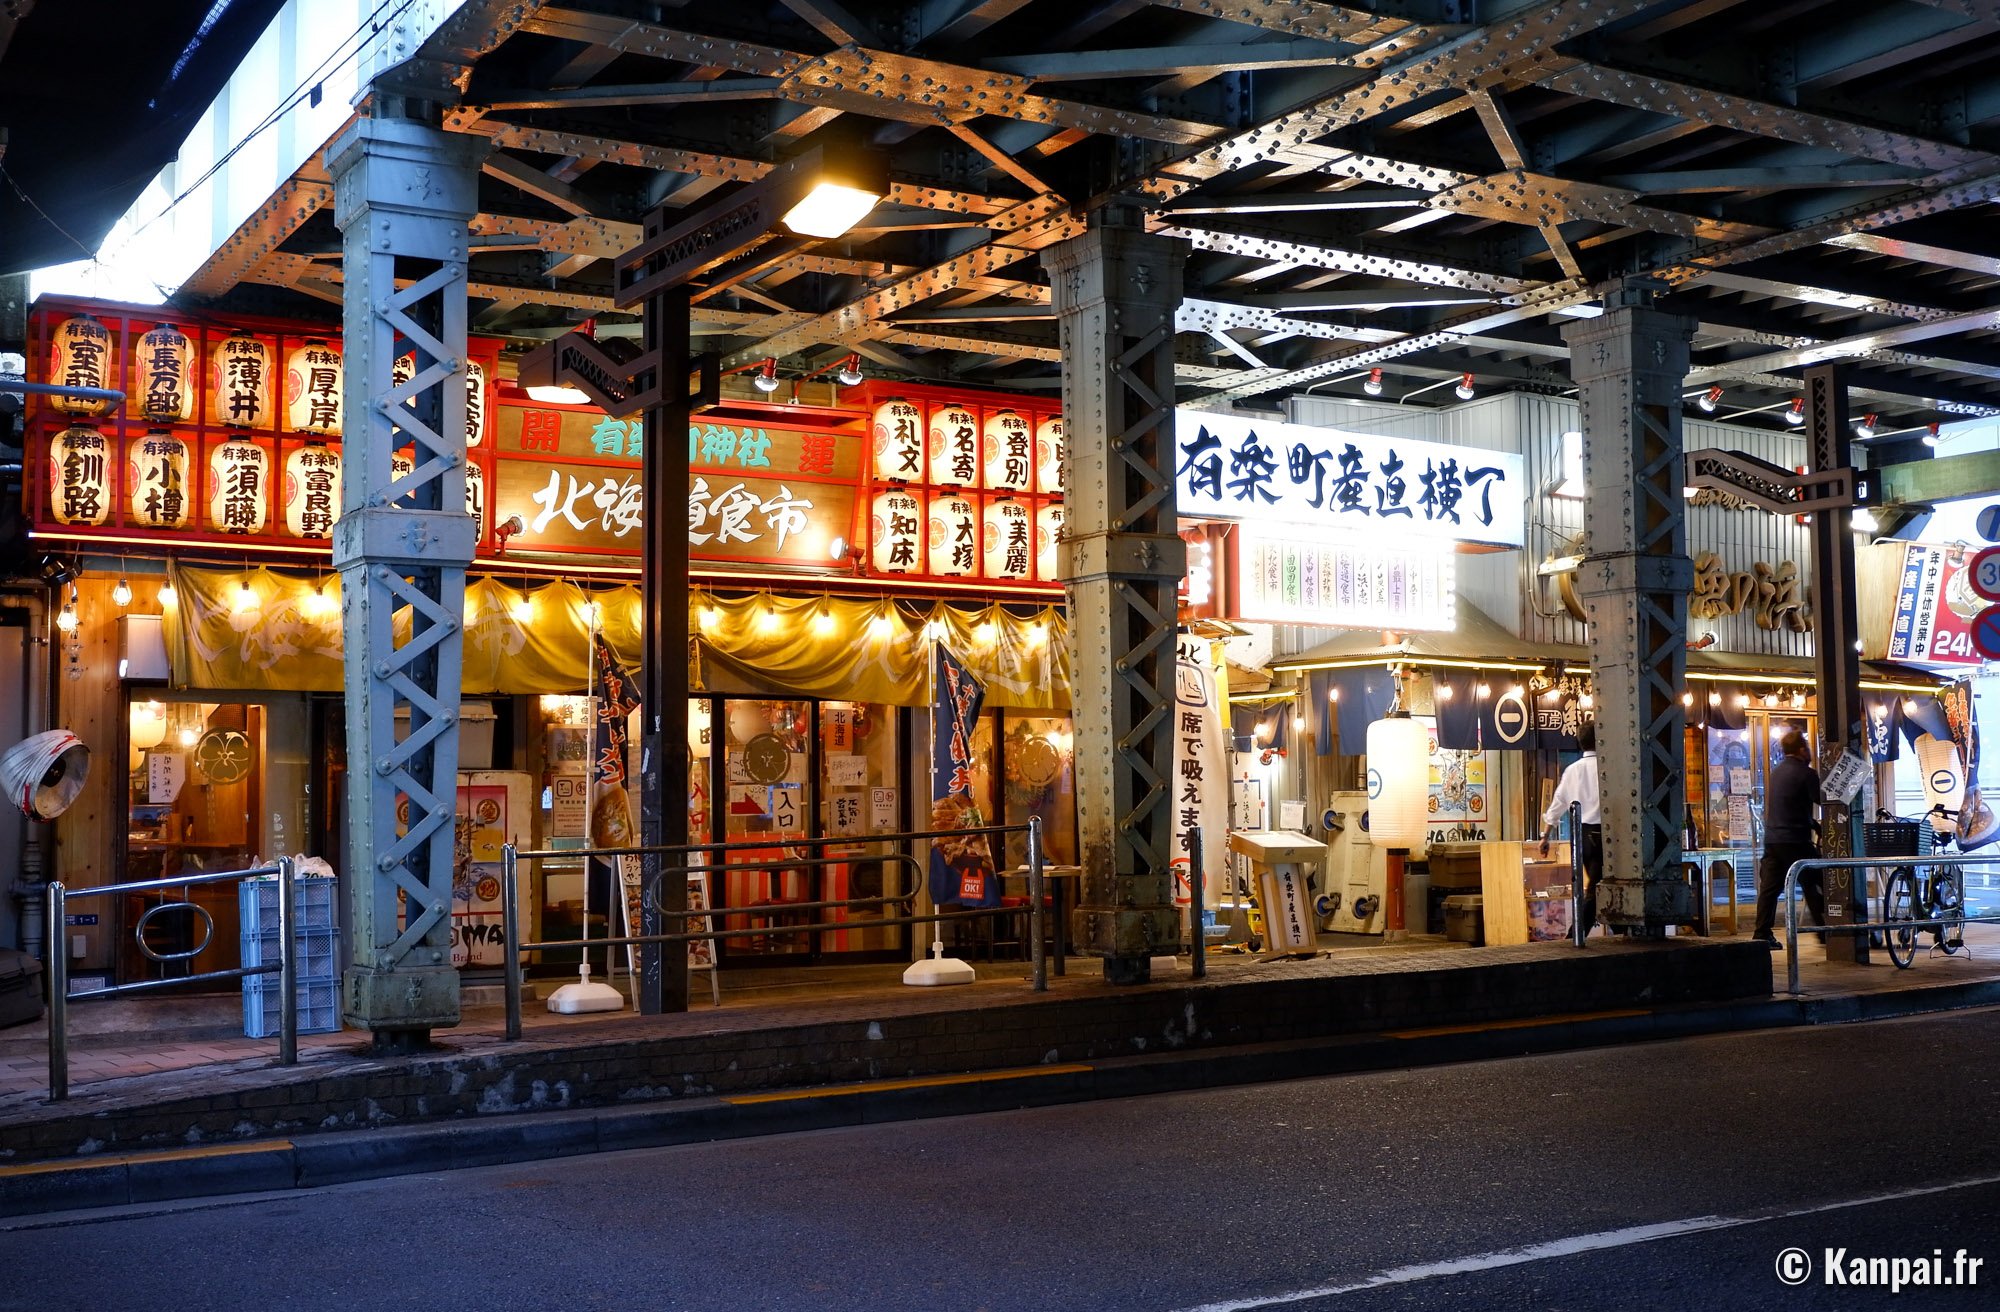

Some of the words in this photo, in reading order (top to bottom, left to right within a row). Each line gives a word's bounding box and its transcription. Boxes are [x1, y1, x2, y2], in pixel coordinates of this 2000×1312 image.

[66, 323, 107, 340] 有楽町
[144, 333, 187, 349] 有楽町
[225, 340, 264, 354] 有楽町
[305, 350, 342, 366] 有楽町
[147, 348, 181, 414] 長万部
[228, 356, 262, 421] 薄井
[308, 367, 339, 429] 厚岸
[62, 435, 105, 451] 有楽町
[144, 441, 184, 456] 有楽町
[222, 447, 262, 461] 有楽町
[301, 453, 338, 468] 有楽町
[521, 411, 561, 452] 開
[798, 434, 835, 474] 運
[894, 418, 920, 473] 礼文
[952, 426, 974, 481] 名寄
[1005, 431, 1029, 485] 登別
[63, 452, 103, 519] 釧路
[145, 457, 183, 523] 小樽
[224, 464, 258, 527] 須藤
[302, 468, 333, 531] 富良野
[1175, 424, 1505, 526] 有楽町産直横丁
[889, 512, 917, 566] 知床
[1915, 551, 1940, 656] 年中無休営業中
[834, 711, 846, 746] 北海道
[691, 782, 707, 825] 入口
[1176, 712, 1203, 851] 席で吸えます
[778, 792, 795, 827] 入口
[964, 883, 980, 893] OK!
[454, 952, 482, 962] Brnd
